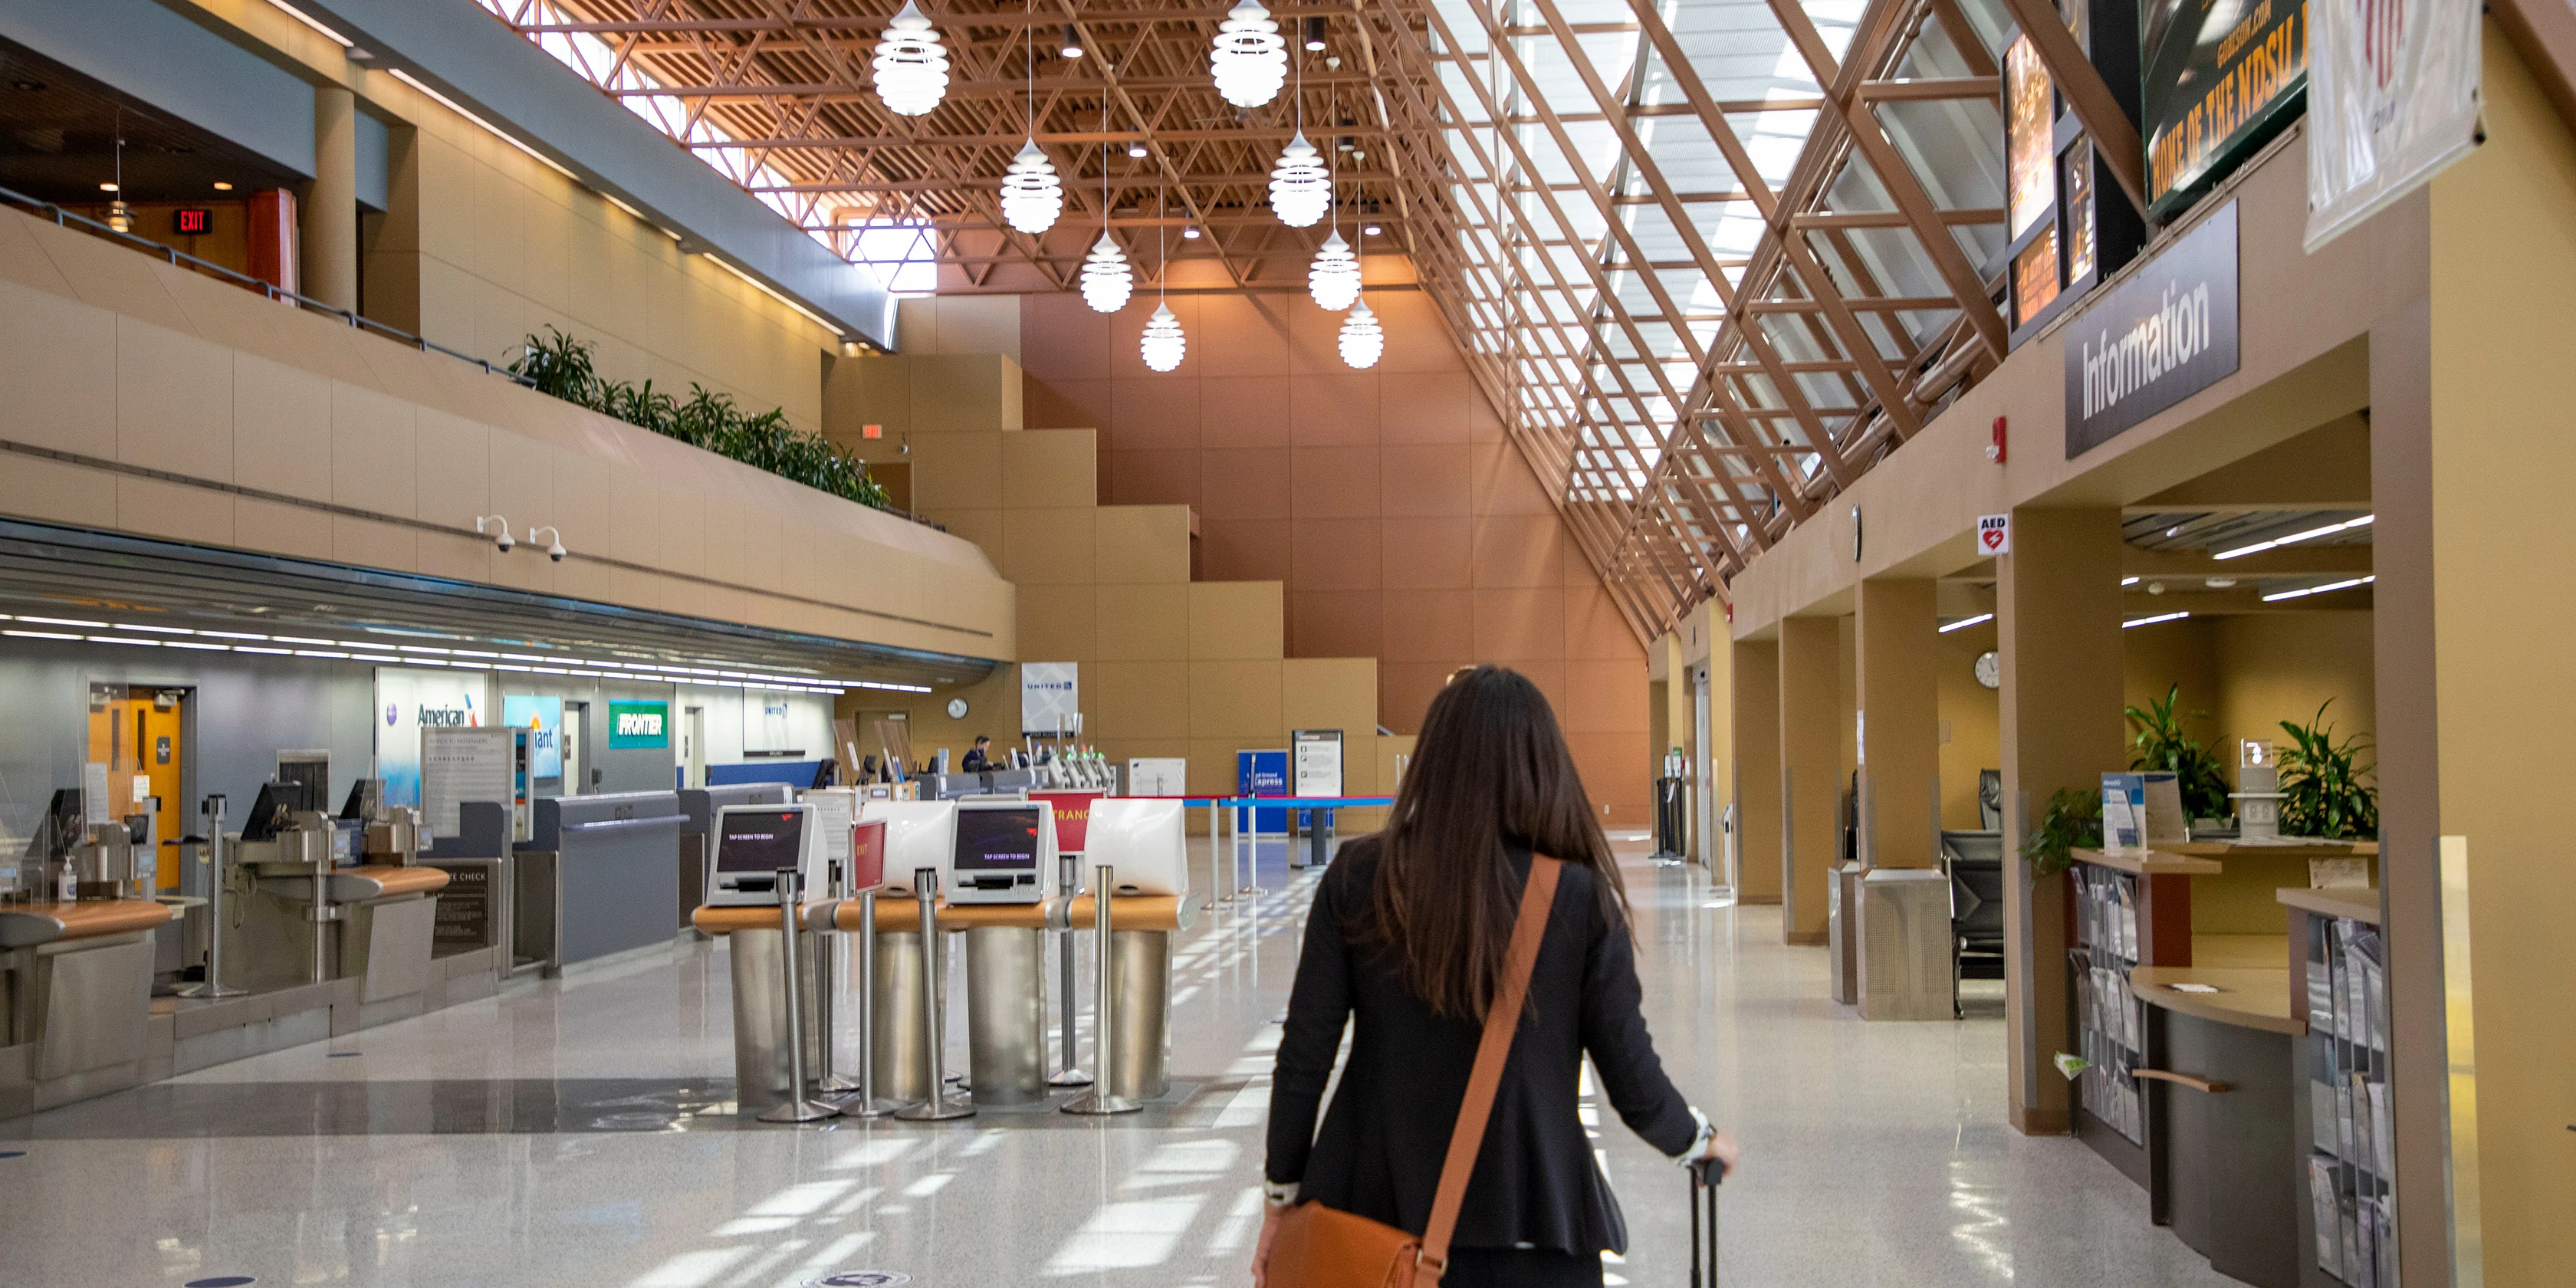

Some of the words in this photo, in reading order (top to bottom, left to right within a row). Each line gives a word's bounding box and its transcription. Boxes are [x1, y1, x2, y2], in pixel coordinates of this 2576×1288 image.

[2152, 120, 2184, 202] HOME
[2187, 101, 2202, 167] OF
[2206, 70, 2235, 151] THE
[2237, 13, 2294, 128] NDSU
[181, 211, 204, 231] EXIT
[2083, 278, 2210, 421] Information
[1981, 518, 2006, 529] AED
[417, 704, 465, 726] American
[764, 706, 783, 715] UNITED
[618, 713, 662, 735] FRONTIER
[856, 844, 868, 856] EXIT
[460, 872, 486, 882] CHECK
